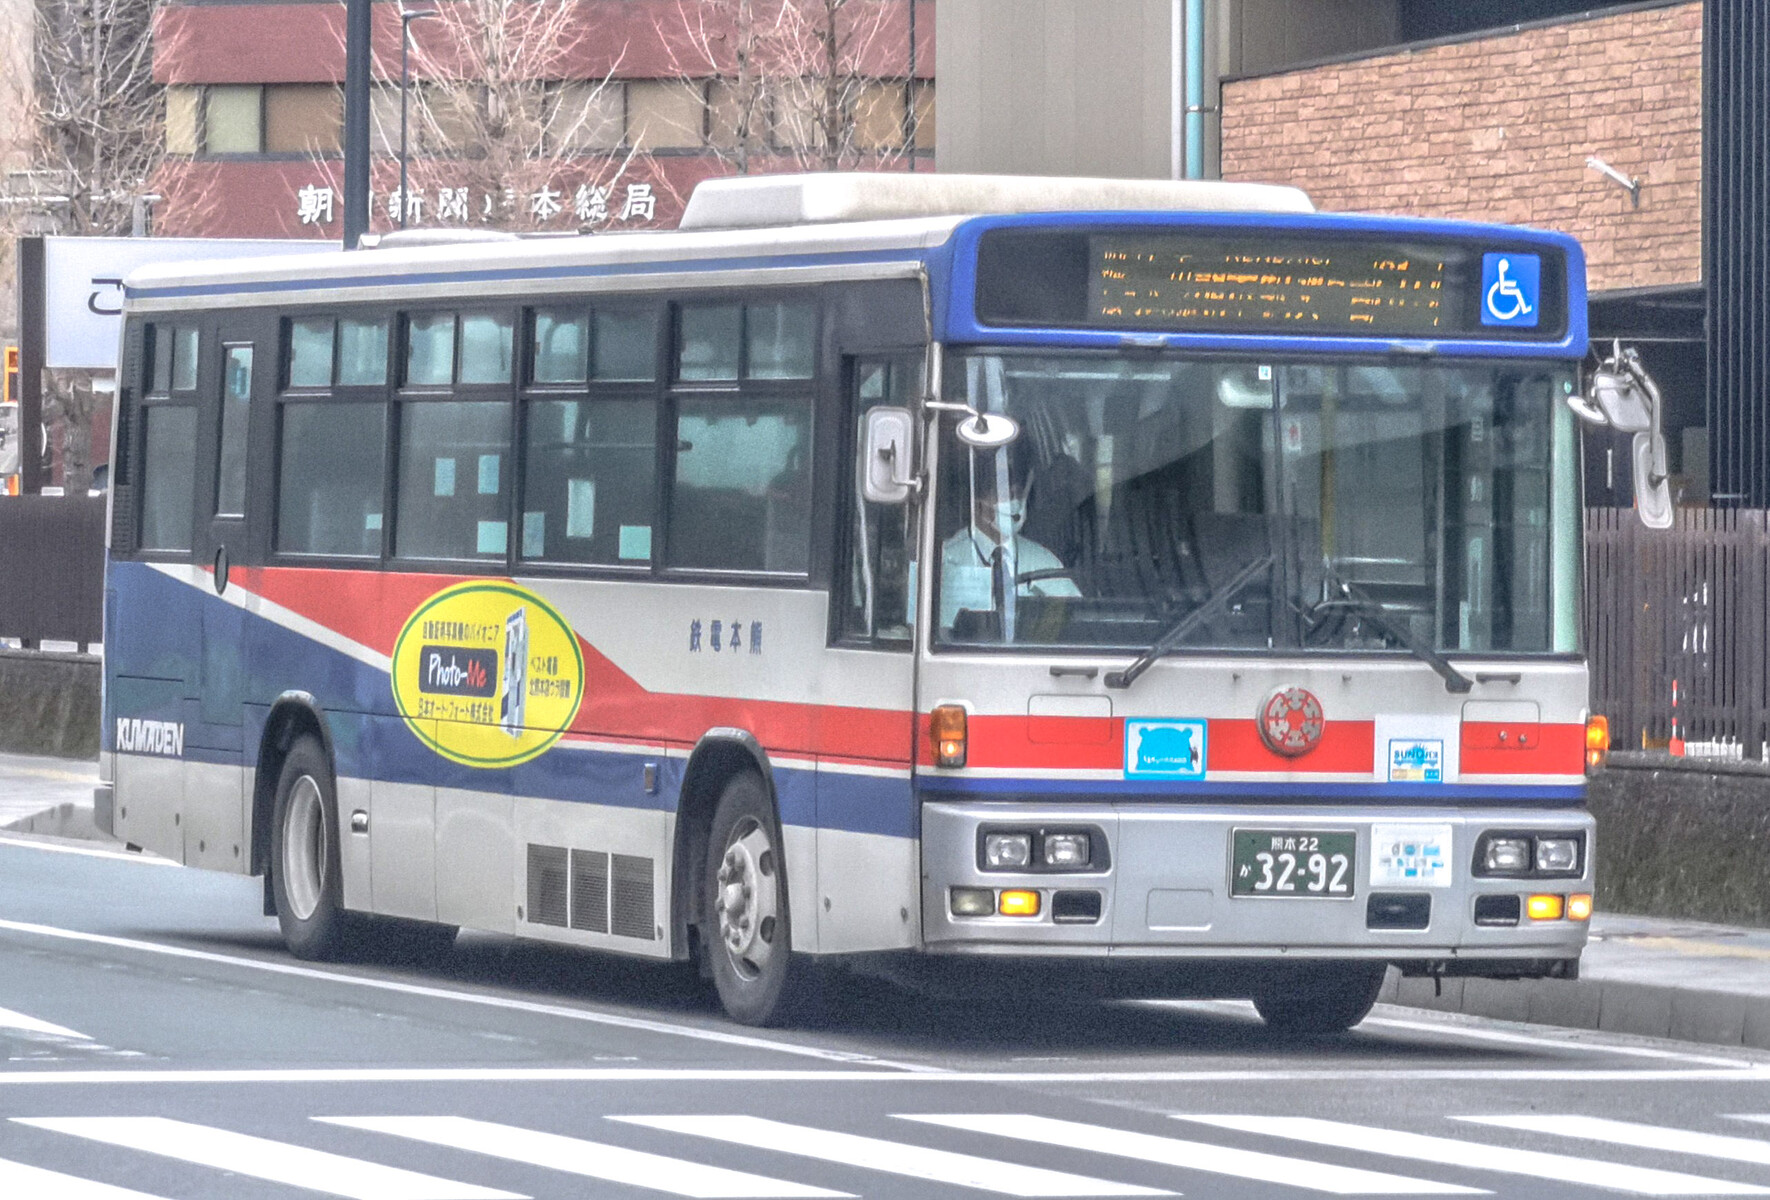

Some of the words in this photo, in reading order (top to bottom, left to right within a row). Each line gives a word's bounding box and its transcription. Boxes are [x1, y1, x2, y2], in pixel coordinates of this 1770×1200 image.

[298, 183, 655, 223] 朝新聞本総局
[428, 653, 487, 688] Photo-Me
[116, 717, 184, 757] KUMADEN
[1254, 852, 1348, 892] 32-92
